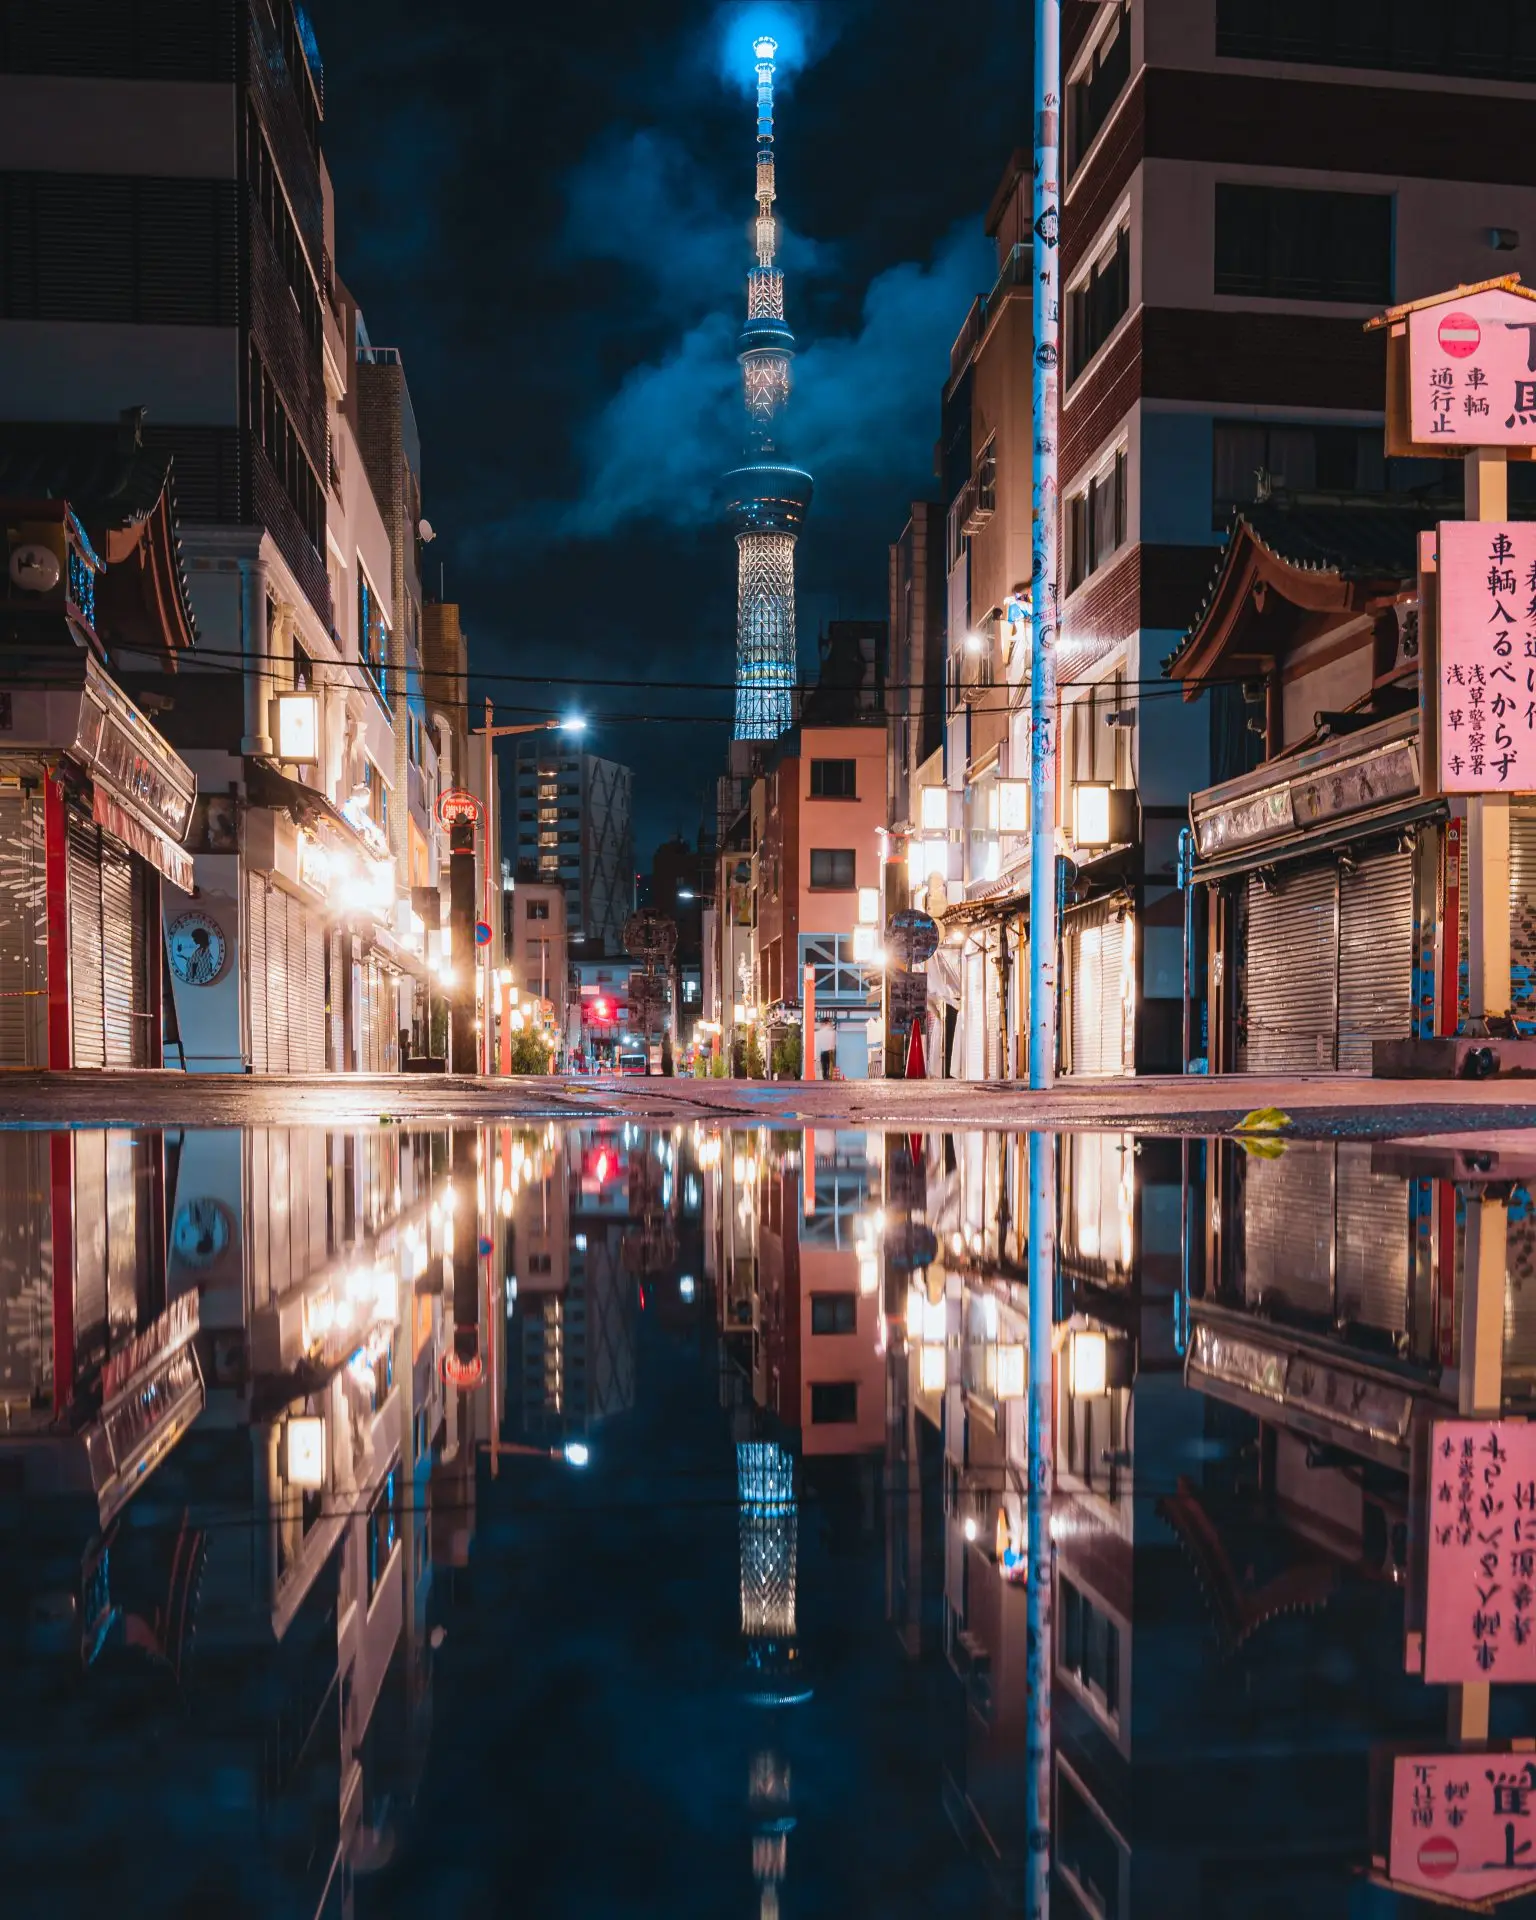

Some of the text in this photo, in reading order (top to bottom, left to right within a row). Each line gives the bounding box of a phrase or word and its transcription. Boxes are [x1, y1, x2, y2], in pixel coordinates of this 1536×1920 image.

[1429, 367, 1455, 434] 通行止
[1487, 533, 1517, 783] 車輌入るべからず
[1446, 664, 1465, 776] 浅草寺
[1468, 664, 1487, 776] 浅草警察署
